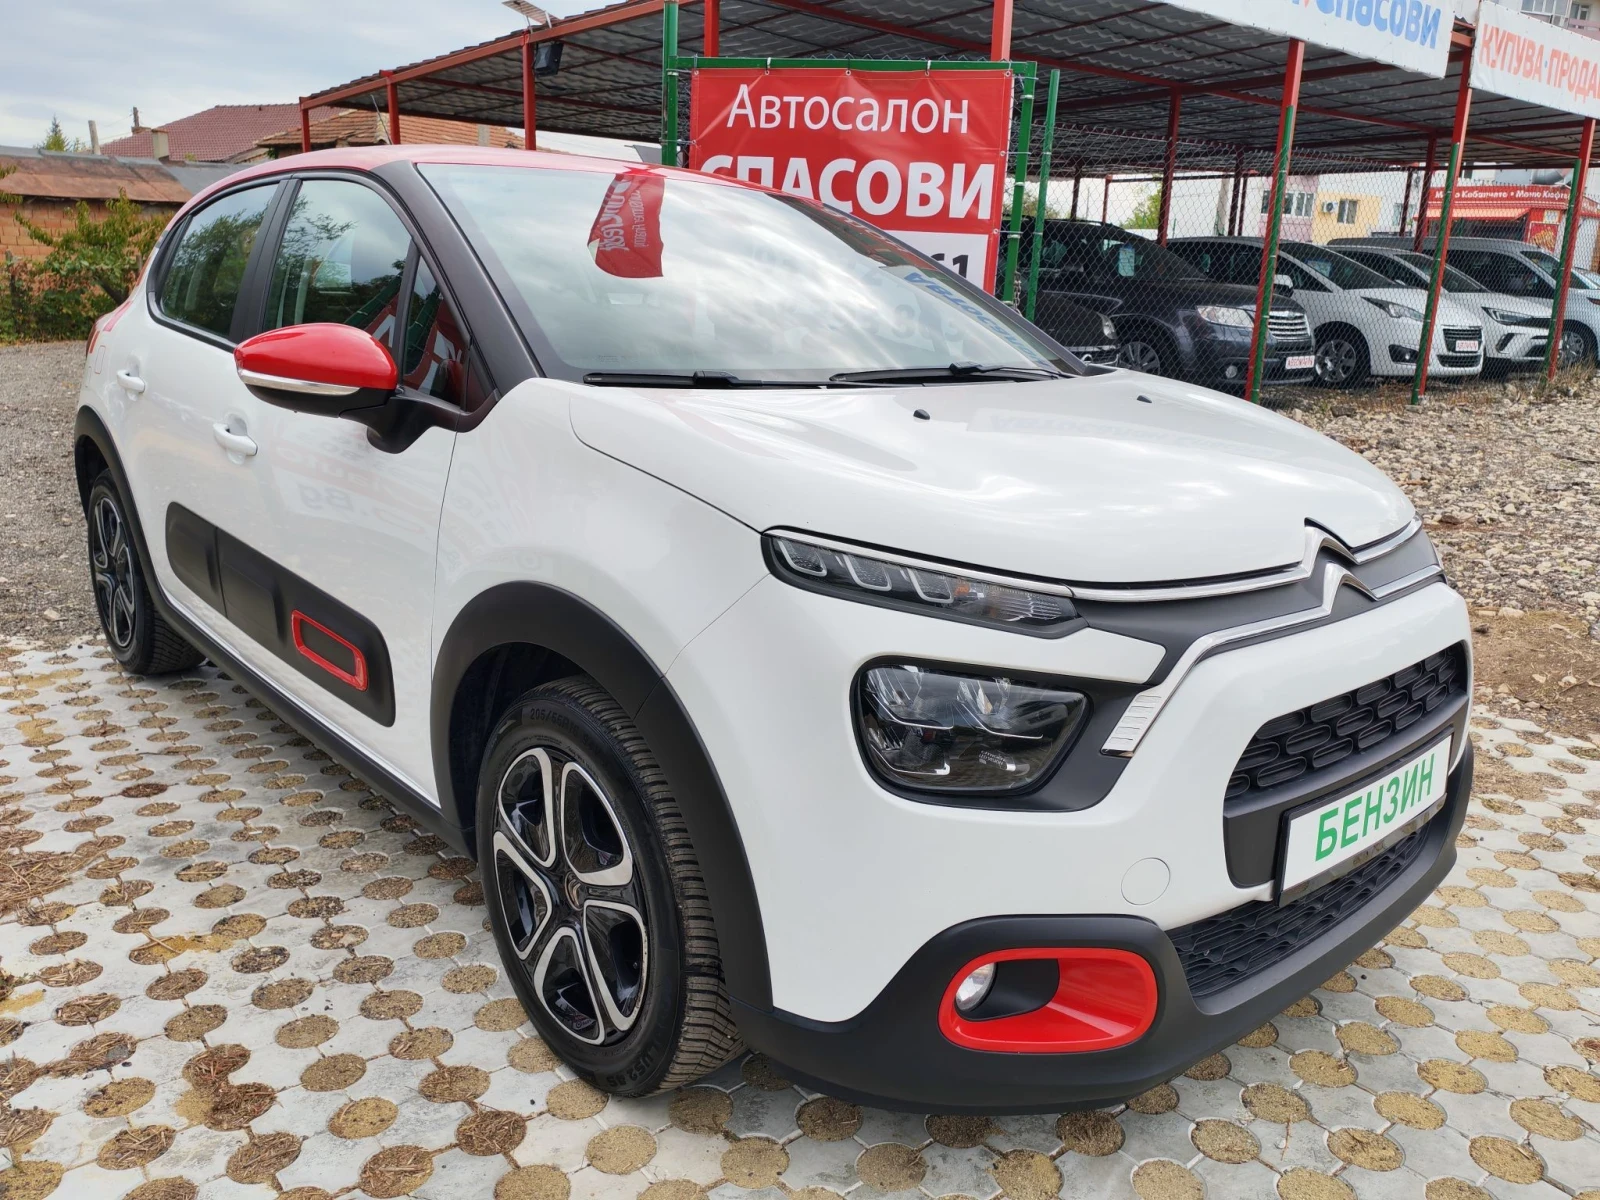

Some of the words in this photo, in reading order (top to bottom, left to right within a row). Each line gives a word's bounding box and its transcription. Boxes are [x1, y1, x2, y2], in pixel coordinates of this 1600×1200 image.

[1546, 49, 1600, 103] ПРОДА
[727, 84, 969, 134] Автосалон
[930, 252, 969, 279] 1
[1315, 753, 1435, 862] БЕНЗИН
